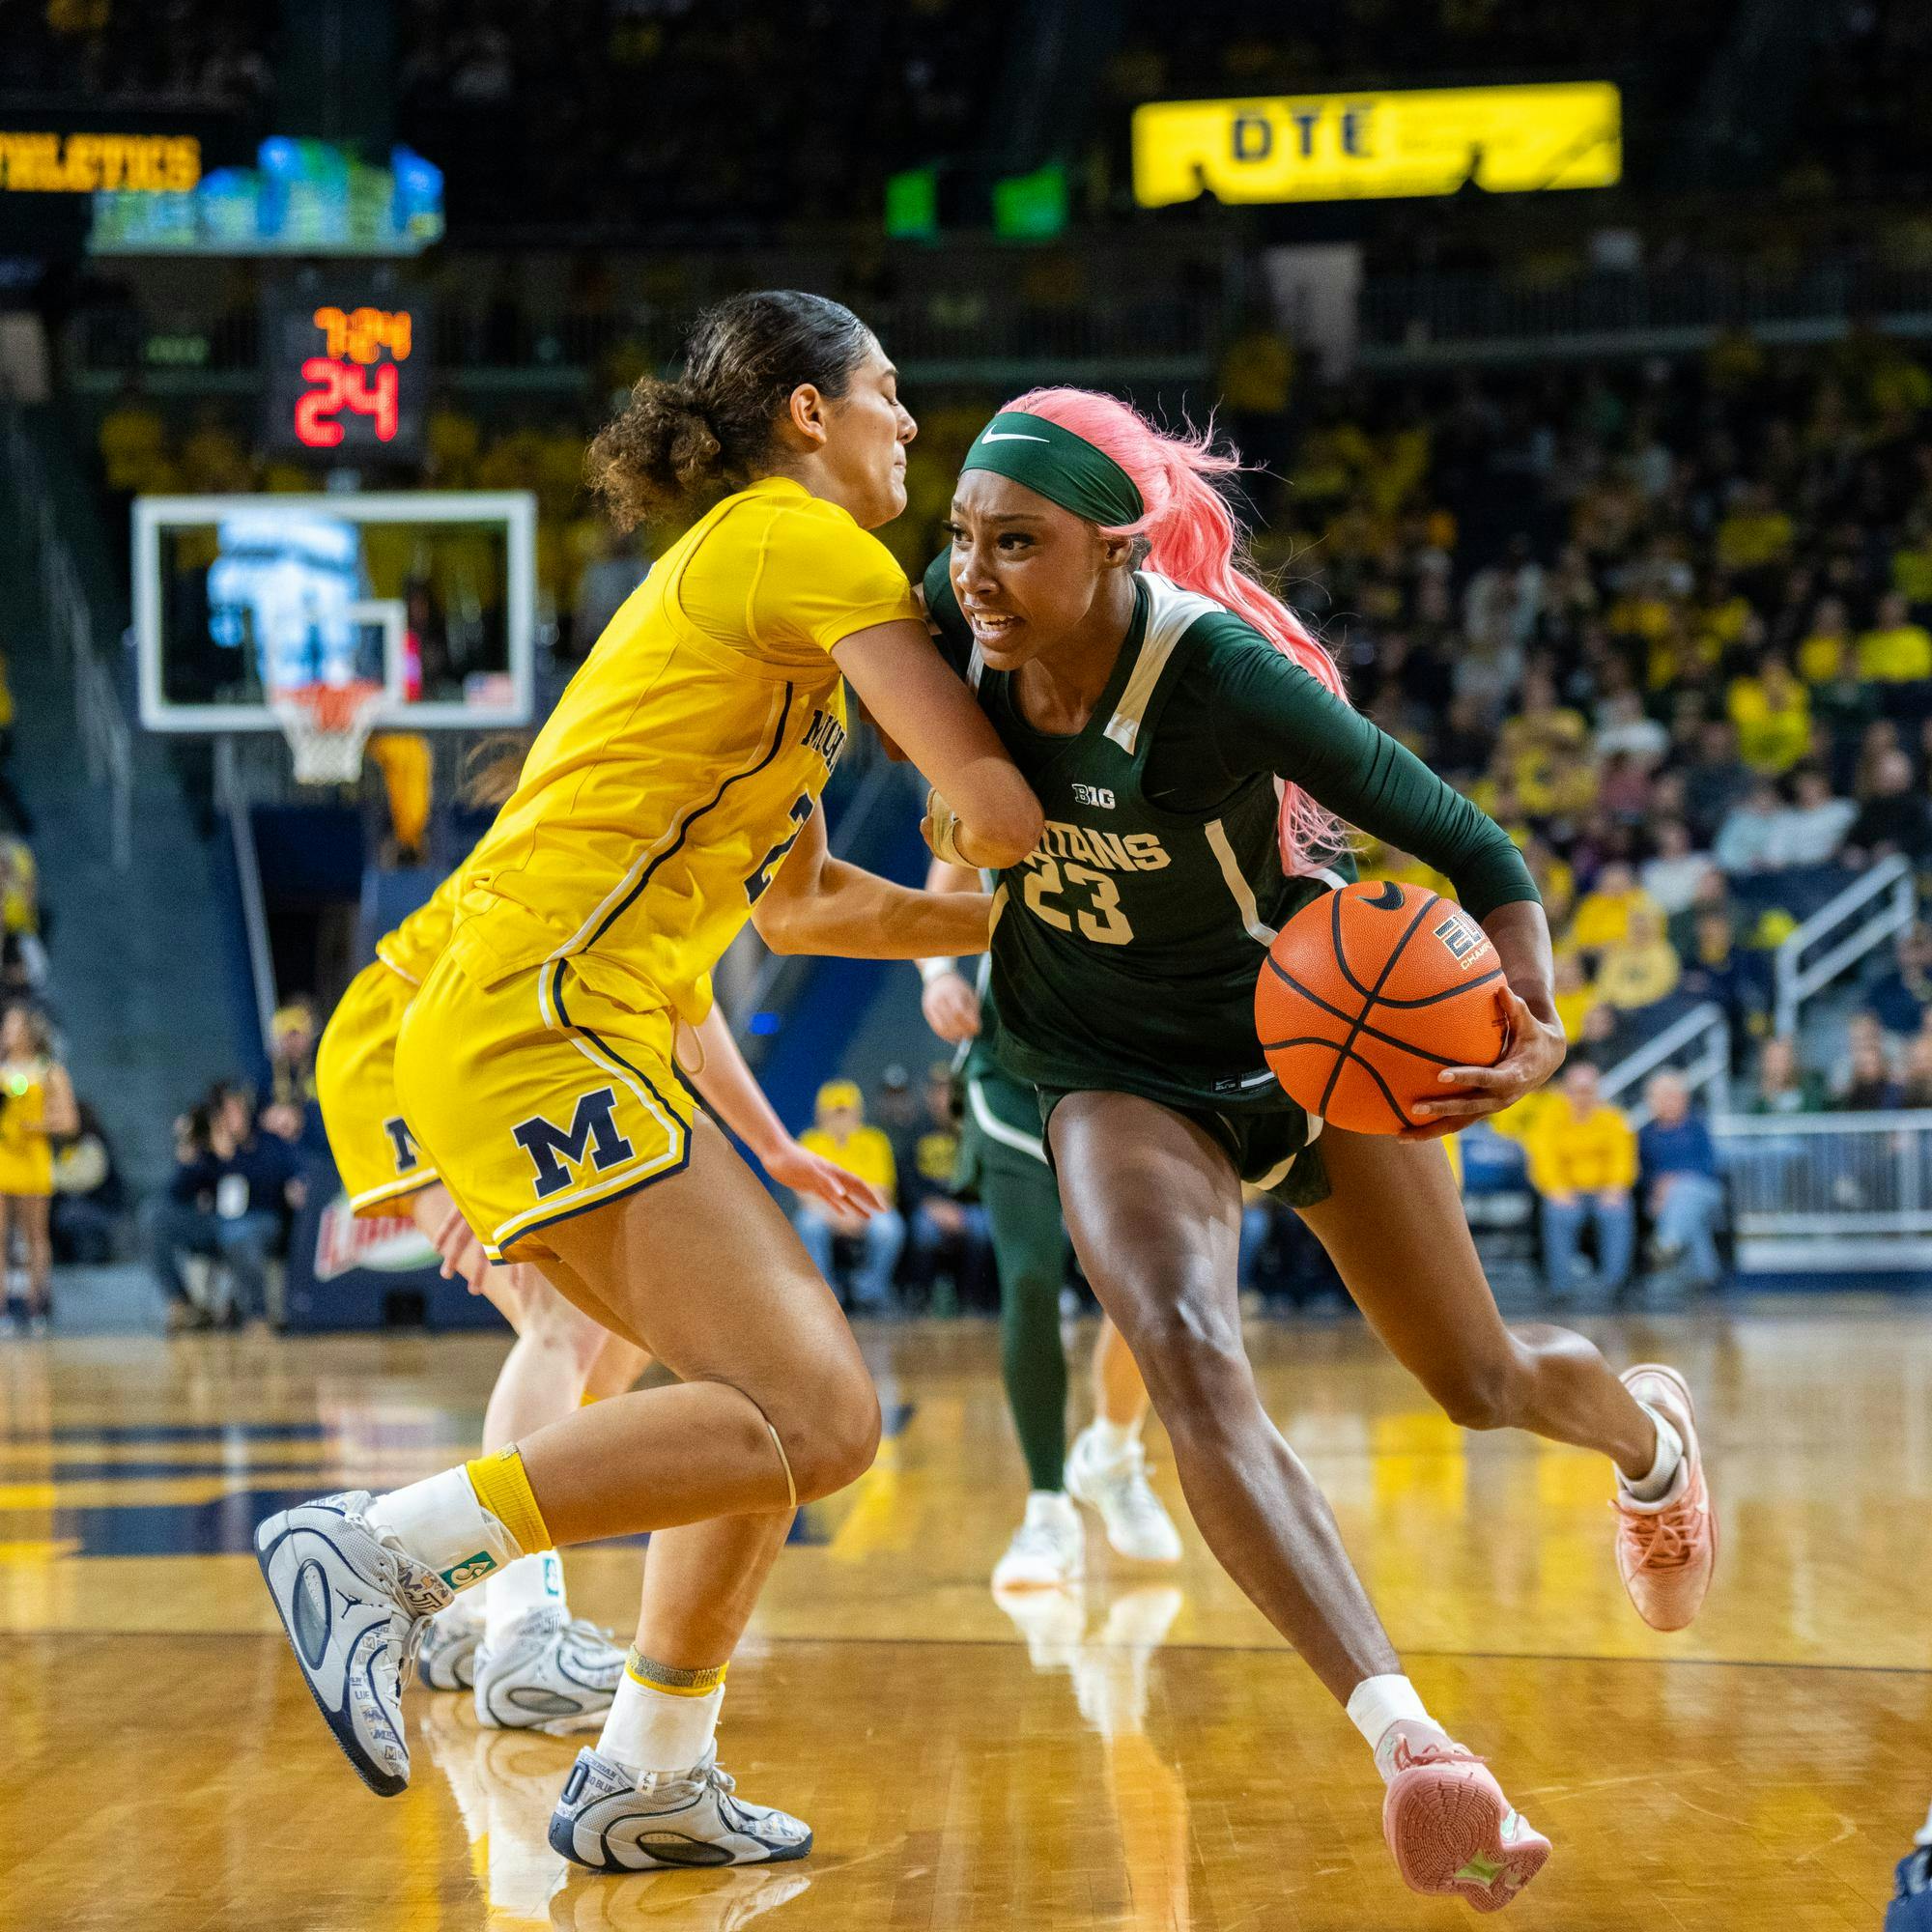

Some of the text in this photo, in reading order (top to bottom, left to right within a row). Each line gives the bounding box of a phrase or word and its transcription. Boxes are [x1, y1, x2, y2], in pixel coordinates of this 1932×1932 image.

[1233, 103, 1376, 163] DTE
[295, 357, 398, 446] 24
[1023, 850, 1135, 946] 23
[510, 1085, 637, 1201] M
